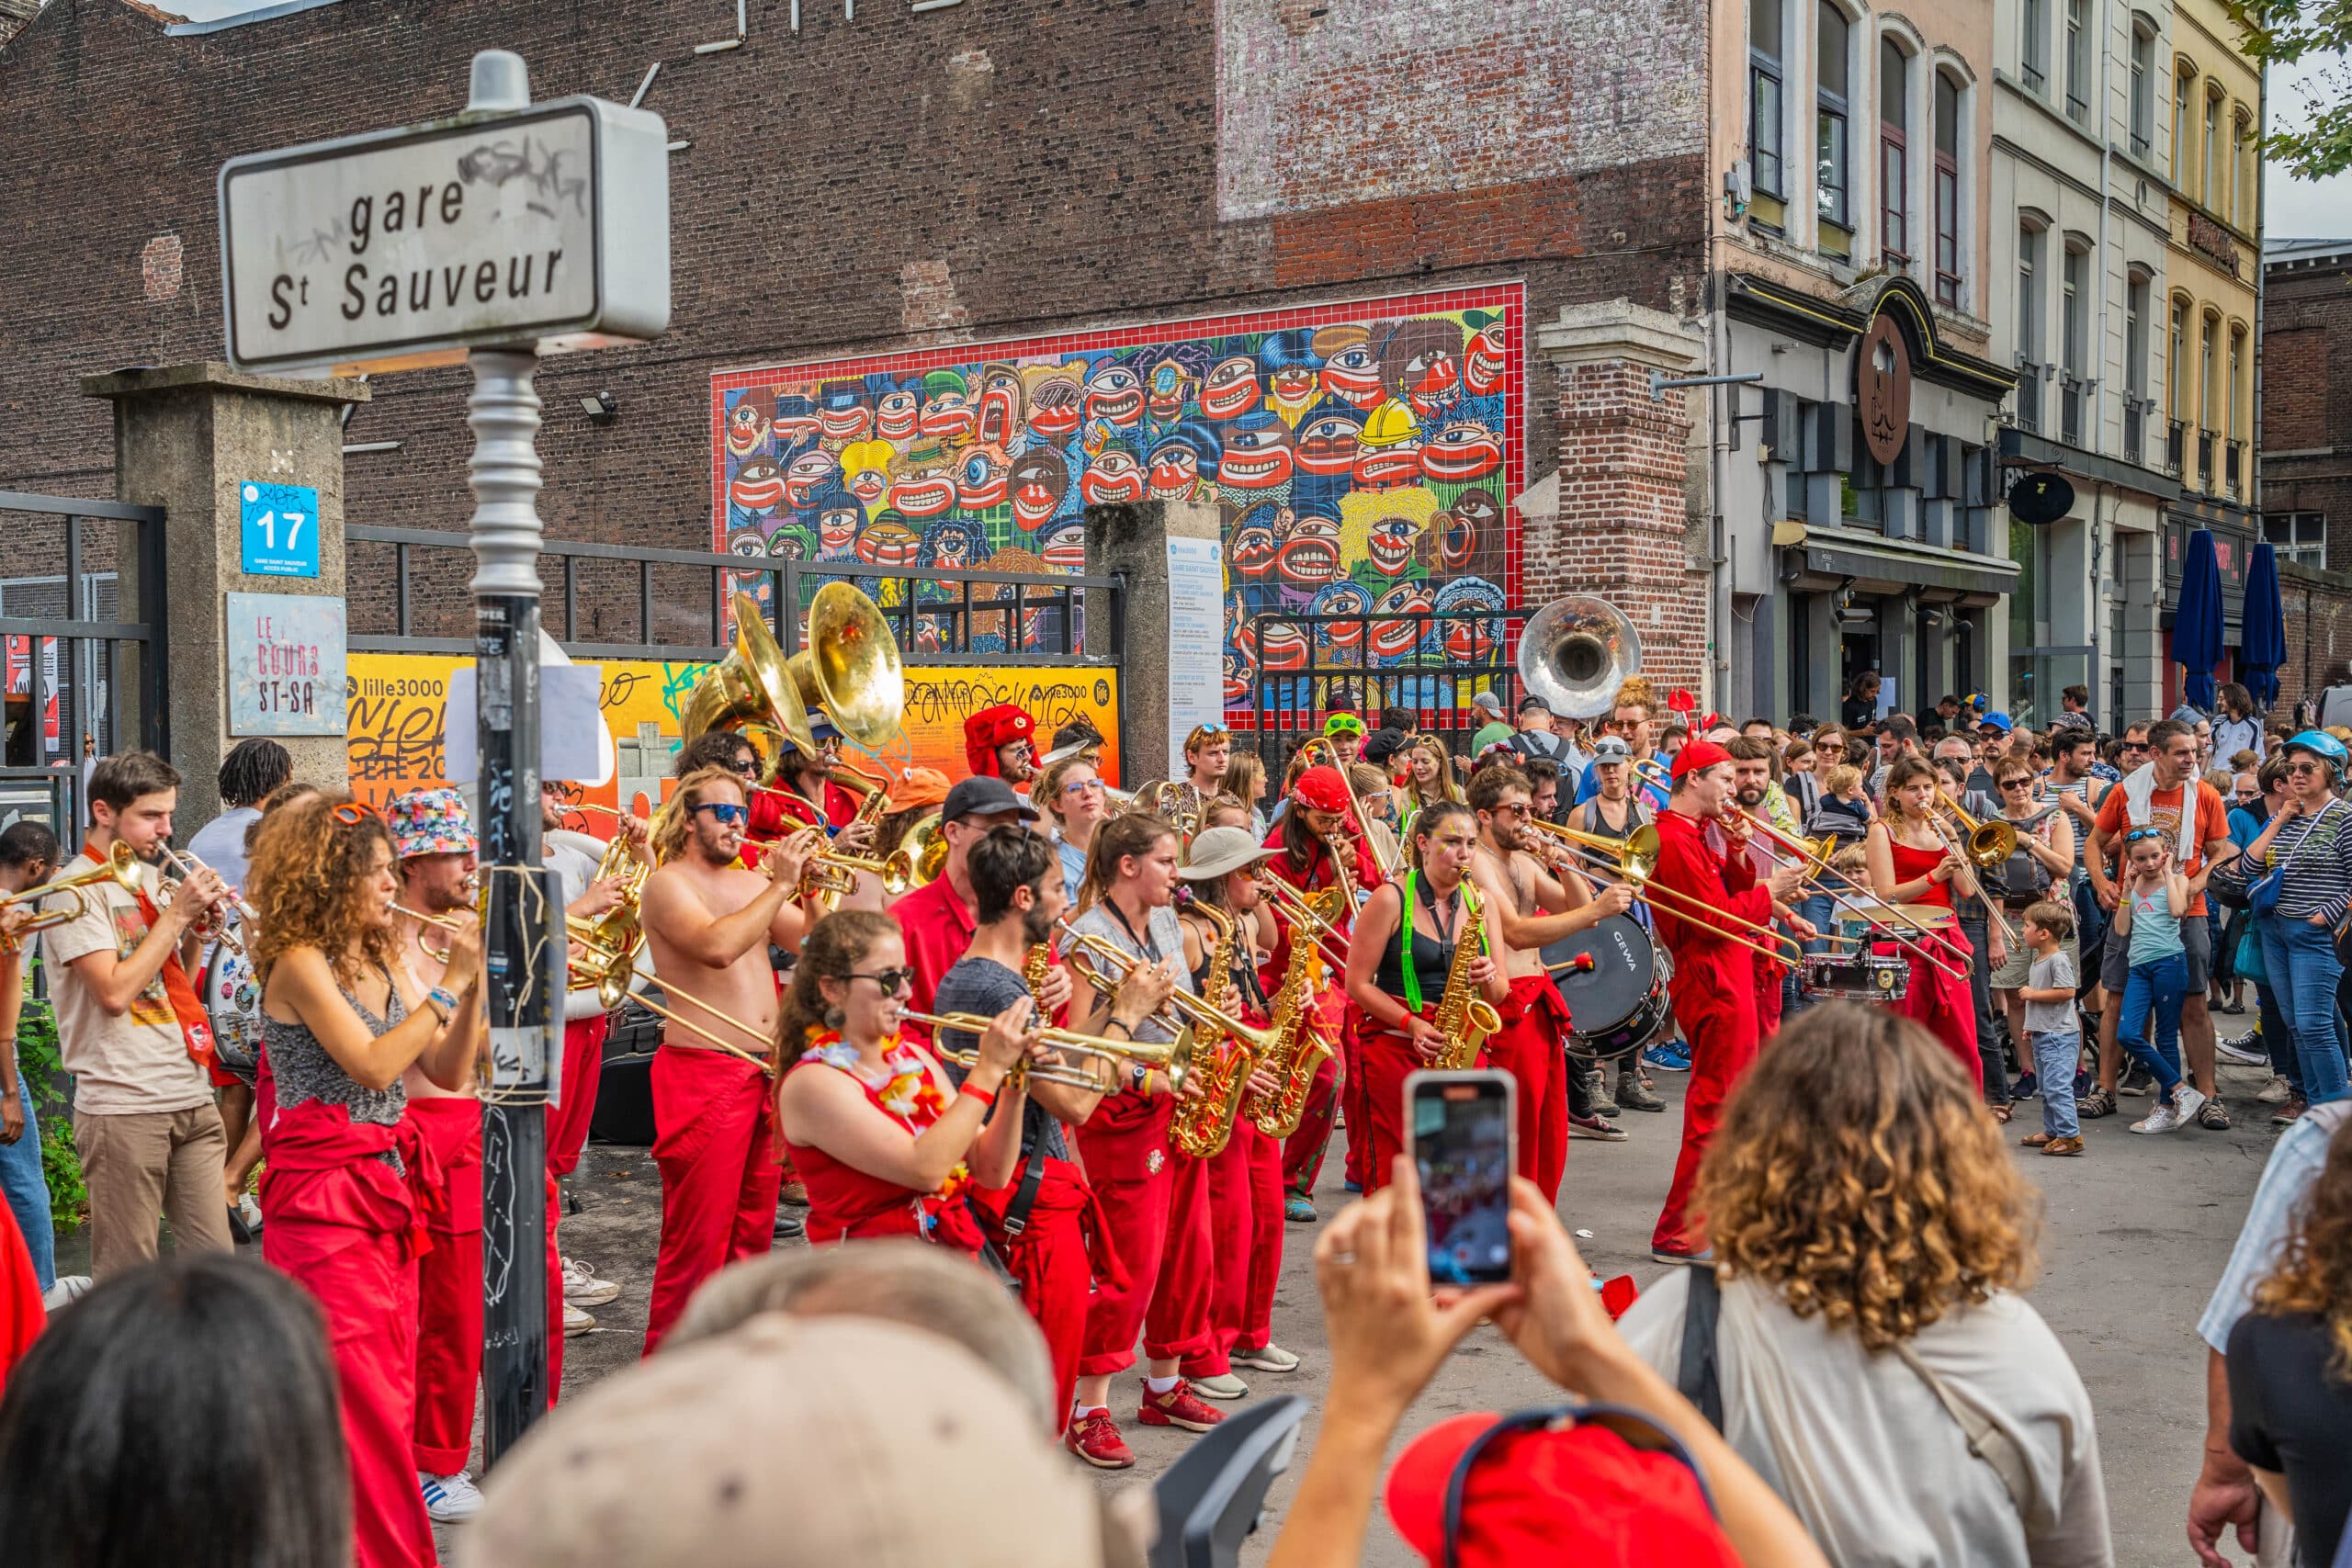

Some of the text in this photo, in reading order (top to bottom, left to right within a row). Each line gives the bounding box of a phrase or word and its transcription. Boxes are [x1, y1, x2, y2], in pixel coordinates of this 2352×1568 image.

[349, 180, 463, 254] gare
[268, 247, 563, 331] St Sauveur
[257, 510, 305, 550] 17
[257, 616, 272, 638] LE
[363, 678, 443, 697] lille3000
[1613, 931, 1636, 972] GEWA
